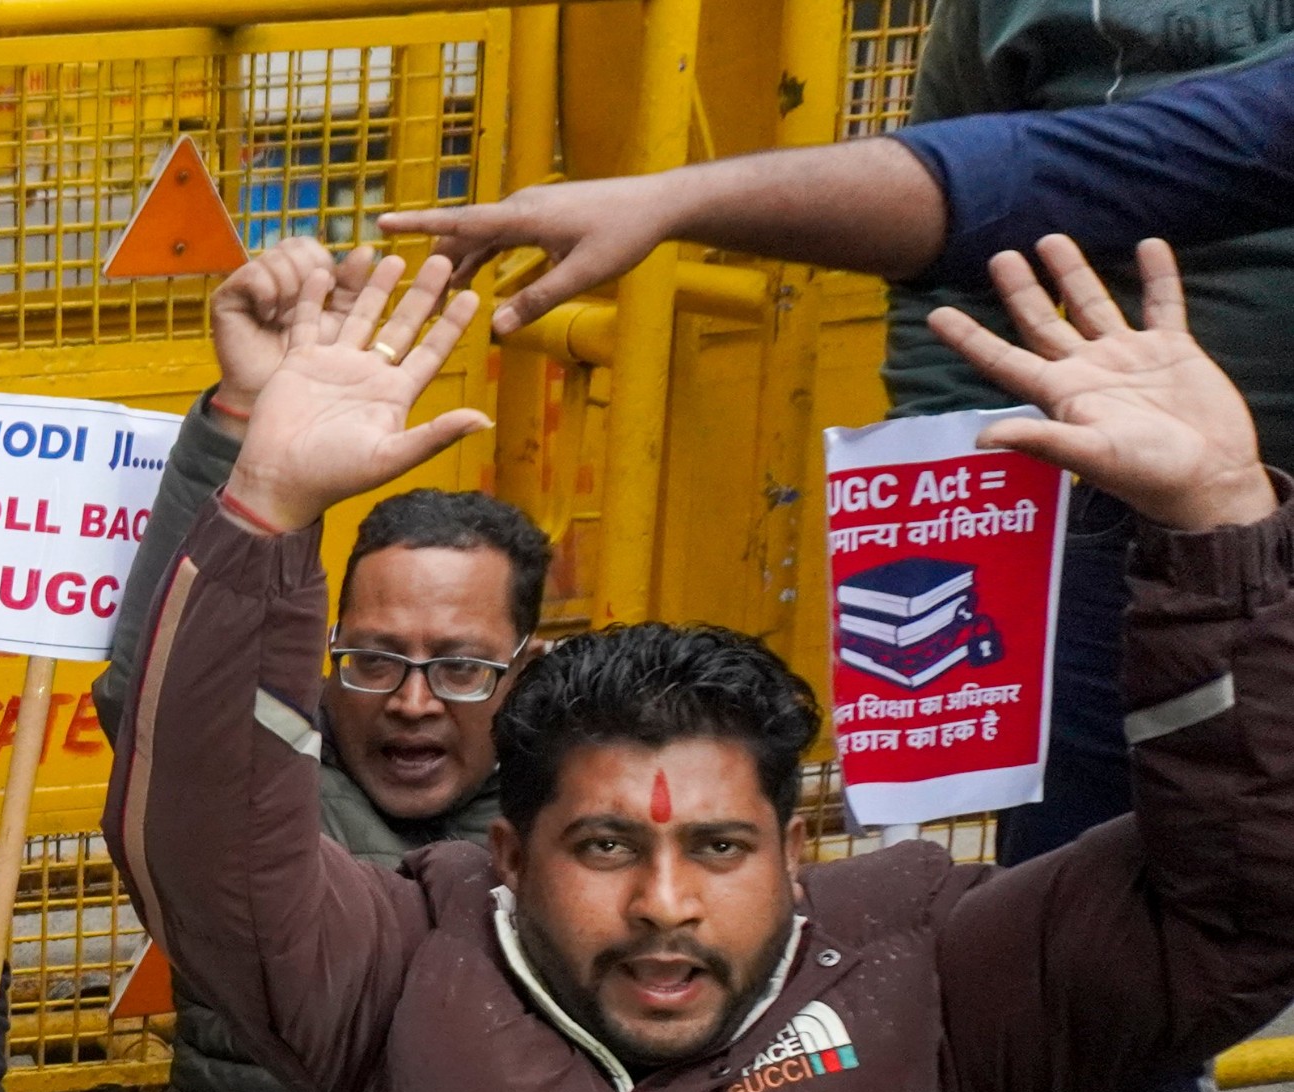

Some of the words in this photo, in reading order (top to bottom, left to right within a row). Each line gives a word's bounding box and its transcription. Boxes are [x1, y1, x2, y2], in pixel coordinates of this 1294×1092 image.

[828, 473, 899, 516] UGC
[910, 467, 971, 506] Act
[79, 503, 152, 542] BAC
[828, 522, 902, 555] मान्य
[906, 509, 949, 545] वर्ग
[951, 498, 1038, 540] विरोधी
[0, 566, 120, 618] UGC
[857, 693, 916, 720] शिक्षा
[918, 694, 944, 716] का
[946, 682, 1022, 711] अधिकार
[850, 729, 901, 752] छात्र
[905, 725, 938, 749] का
[940, 718, 978, 747] हक
[980, 709, 1000, 740] है
